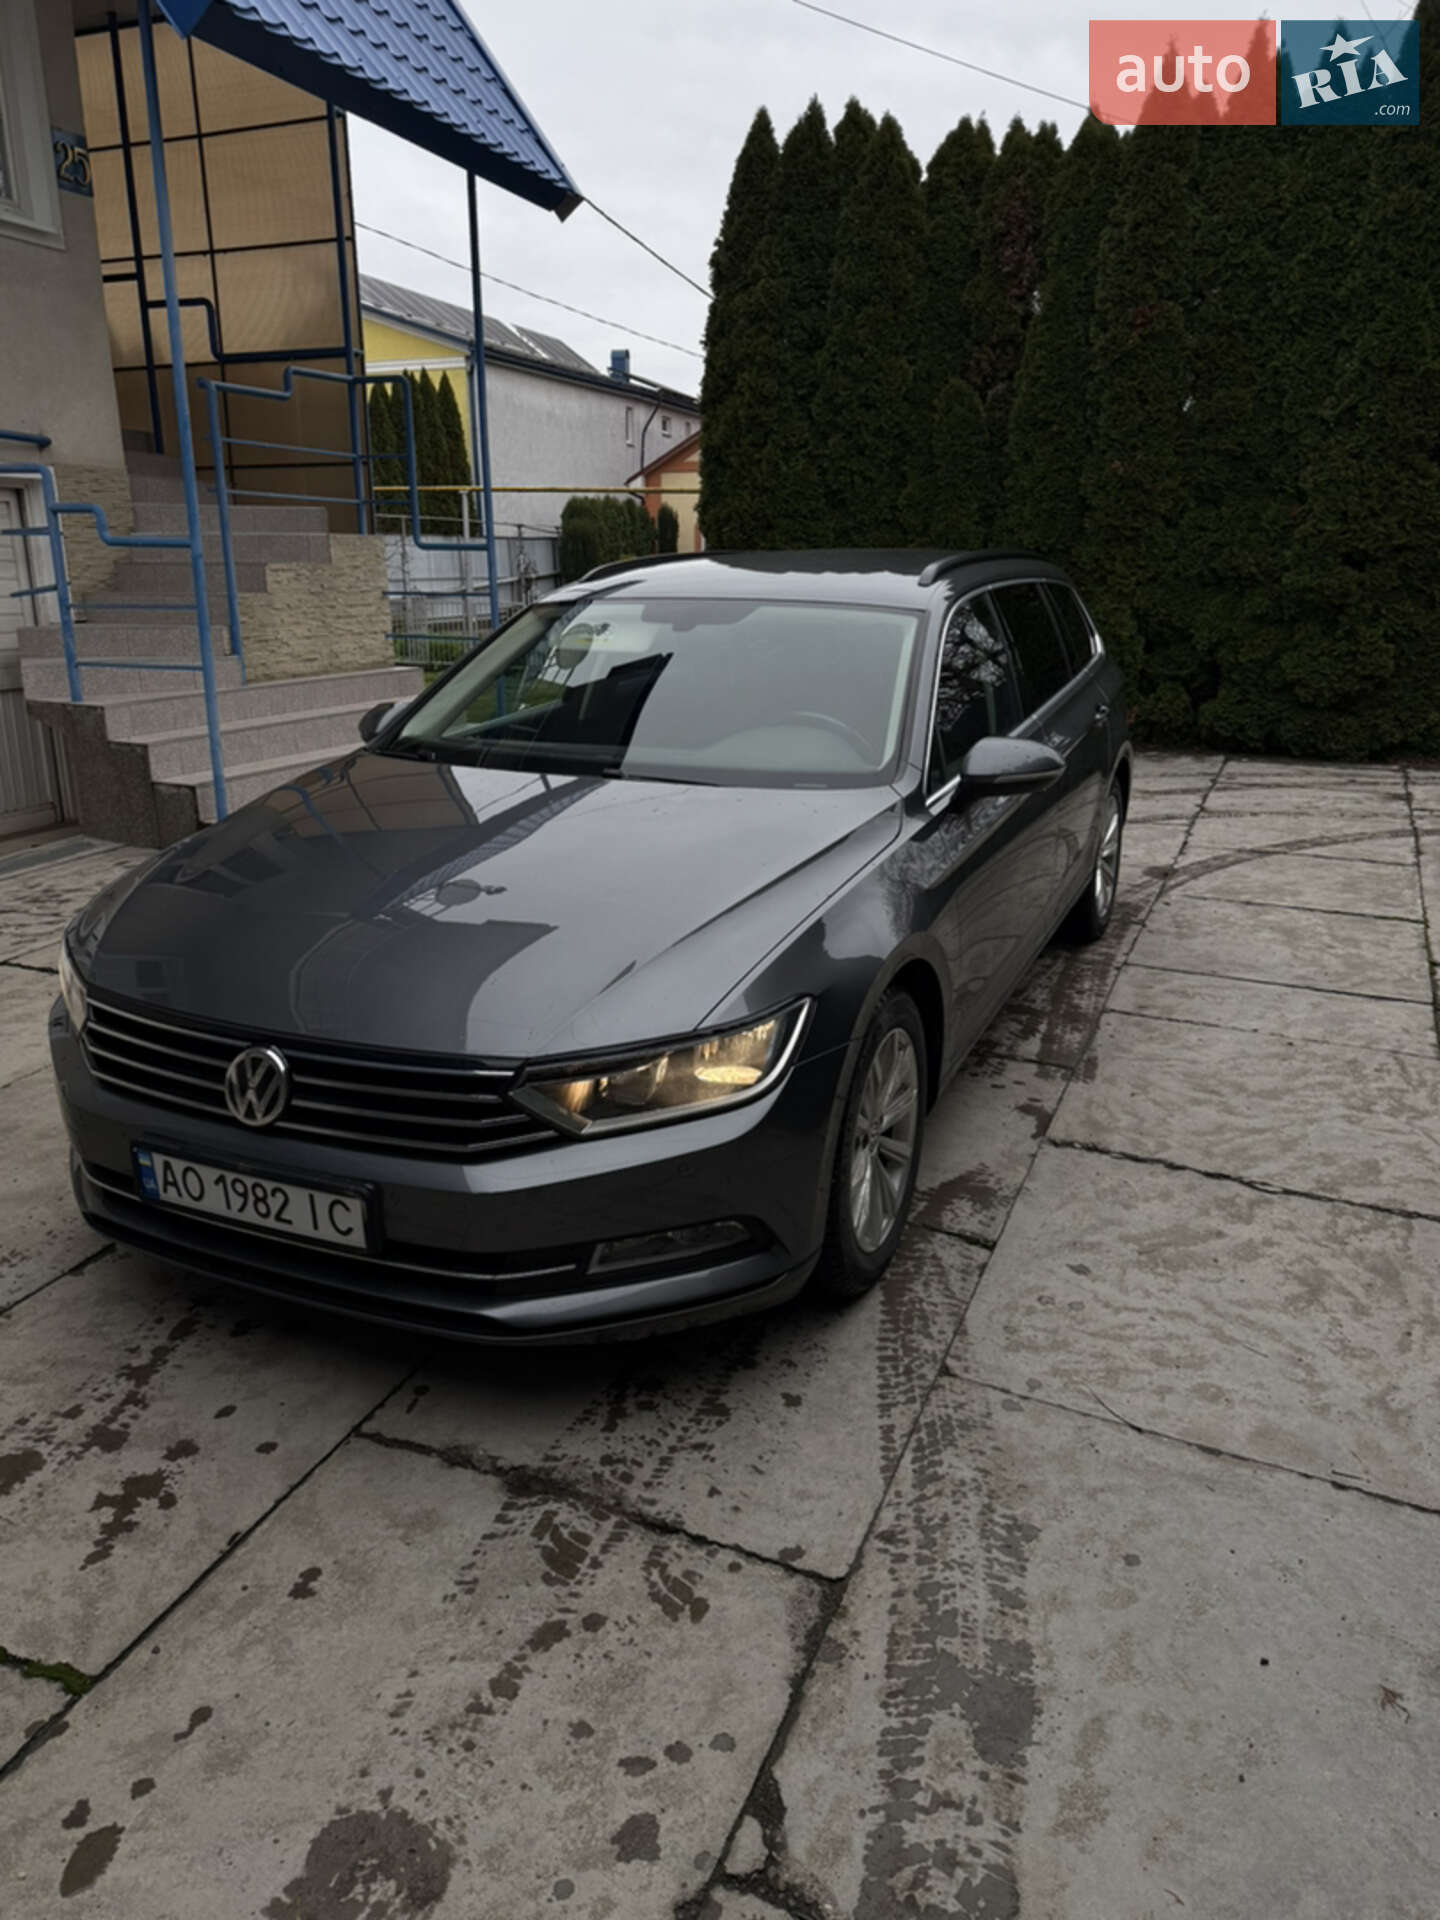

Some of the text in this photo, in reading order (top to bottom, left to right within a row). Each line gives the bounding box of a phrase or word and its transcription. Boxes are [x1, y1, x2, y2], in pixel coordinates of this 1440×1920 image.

[54, 141, 90, 188] 25
[162, 1160, 353, 1236] AO 1982 IC
